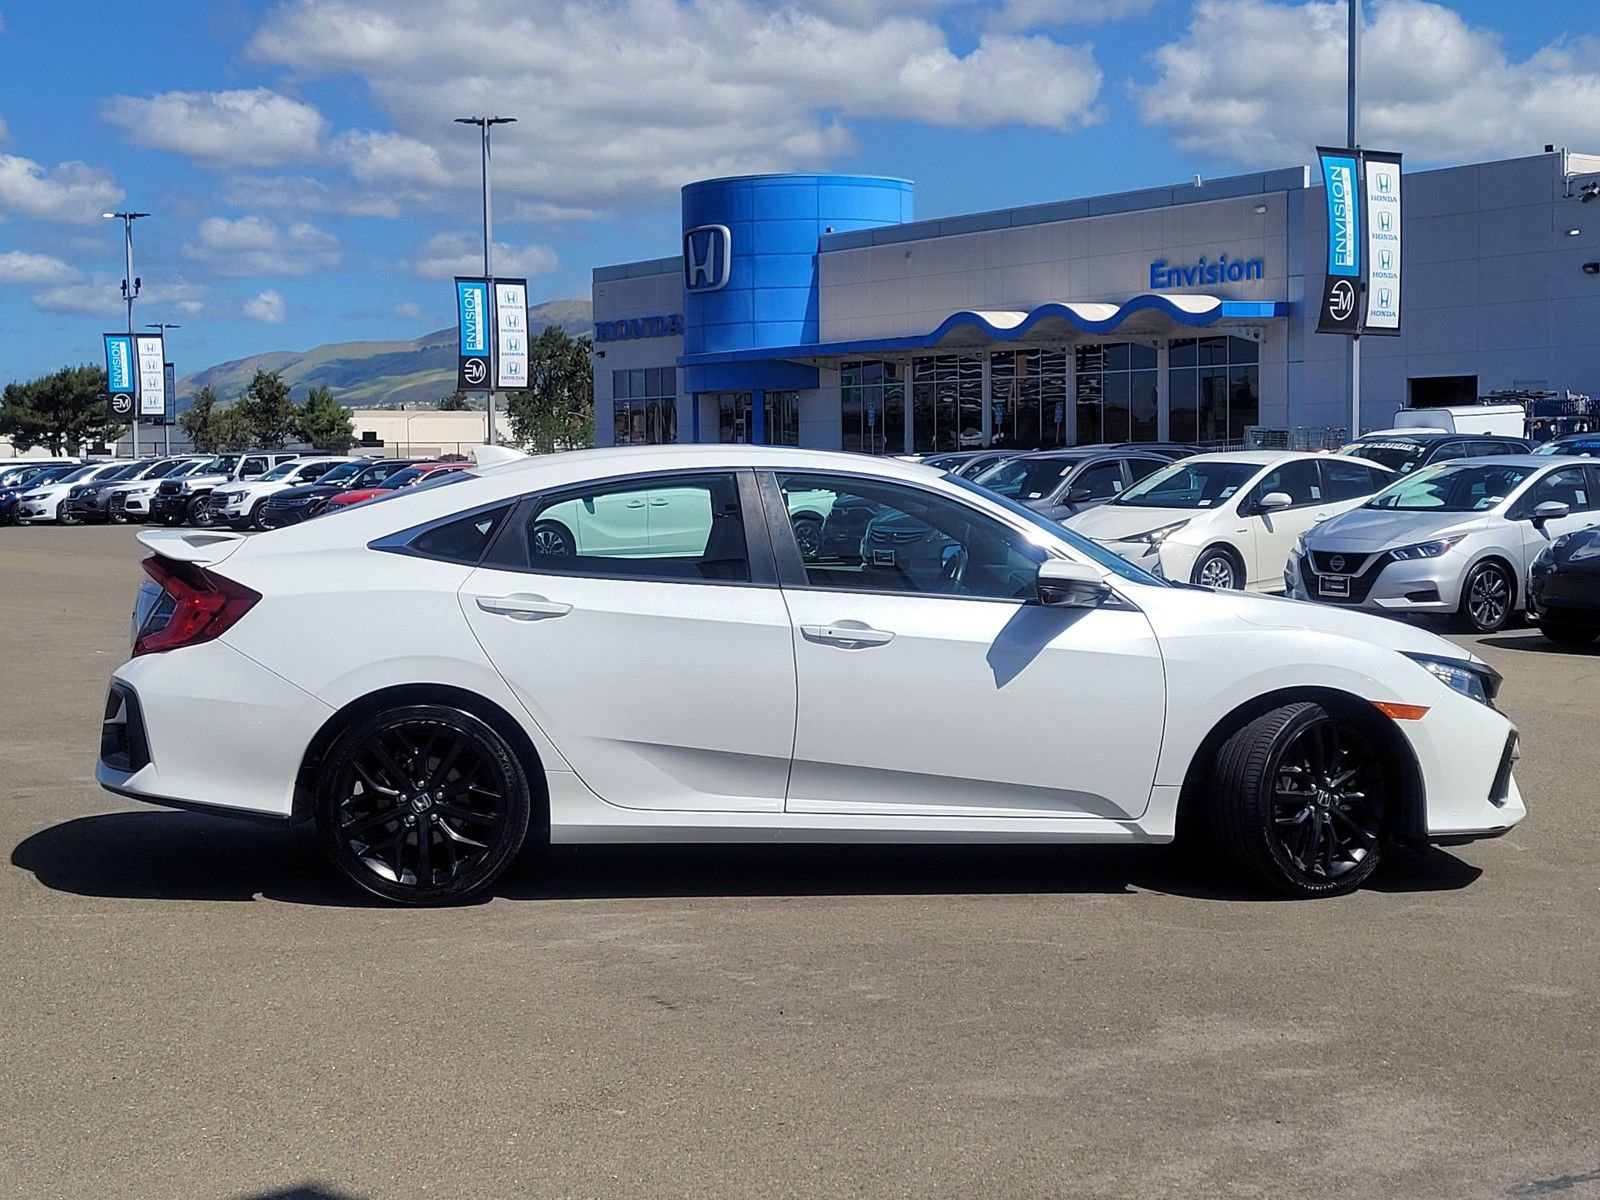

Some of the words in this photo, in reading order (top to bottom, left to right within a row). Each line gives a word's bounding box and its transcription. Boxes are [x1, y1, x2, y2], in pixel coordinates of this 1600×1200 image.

[1370, 194, 1397, 202] HONDA
[1330, 166, 1347, 266] ENVISION
[1372, 232, 1398, 240] HONDA
[1150, 252, 1265, 289] Envision
[1372, 271, 1398, 279] HONDA
[464, 288, 476, 350] ENVISION
[594, 314, 684, 342] HONDA
[1370, 310, 1397, 318] HONDA
[111, 341, 123, 388] ENVISION
